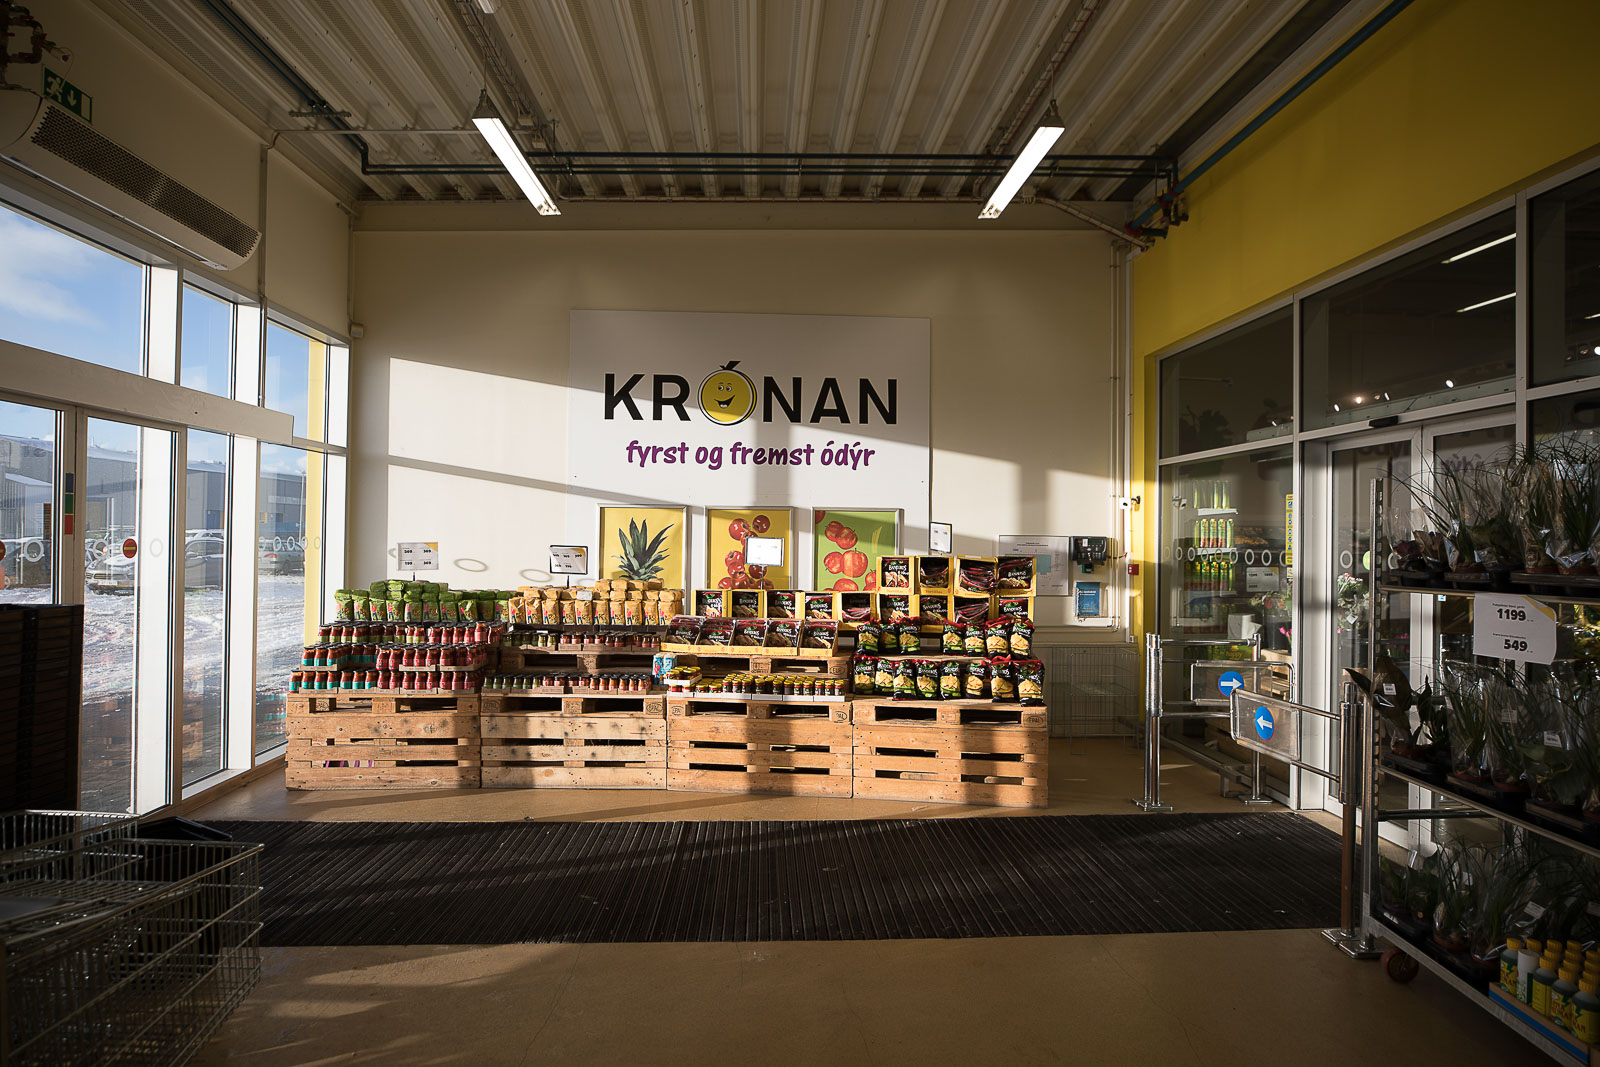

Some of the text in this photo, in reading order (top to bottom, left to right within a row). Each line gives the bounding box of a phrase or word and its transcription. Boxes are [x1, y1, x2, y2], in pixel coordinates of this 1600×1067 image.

[604, 361, 898, 426] KRÓNAN
[625, 440, 875, 470] fyrst og fremst ódýr
[1497, 608, 1526, 621] 1199
[1504, 638, 1528, 651] 549
